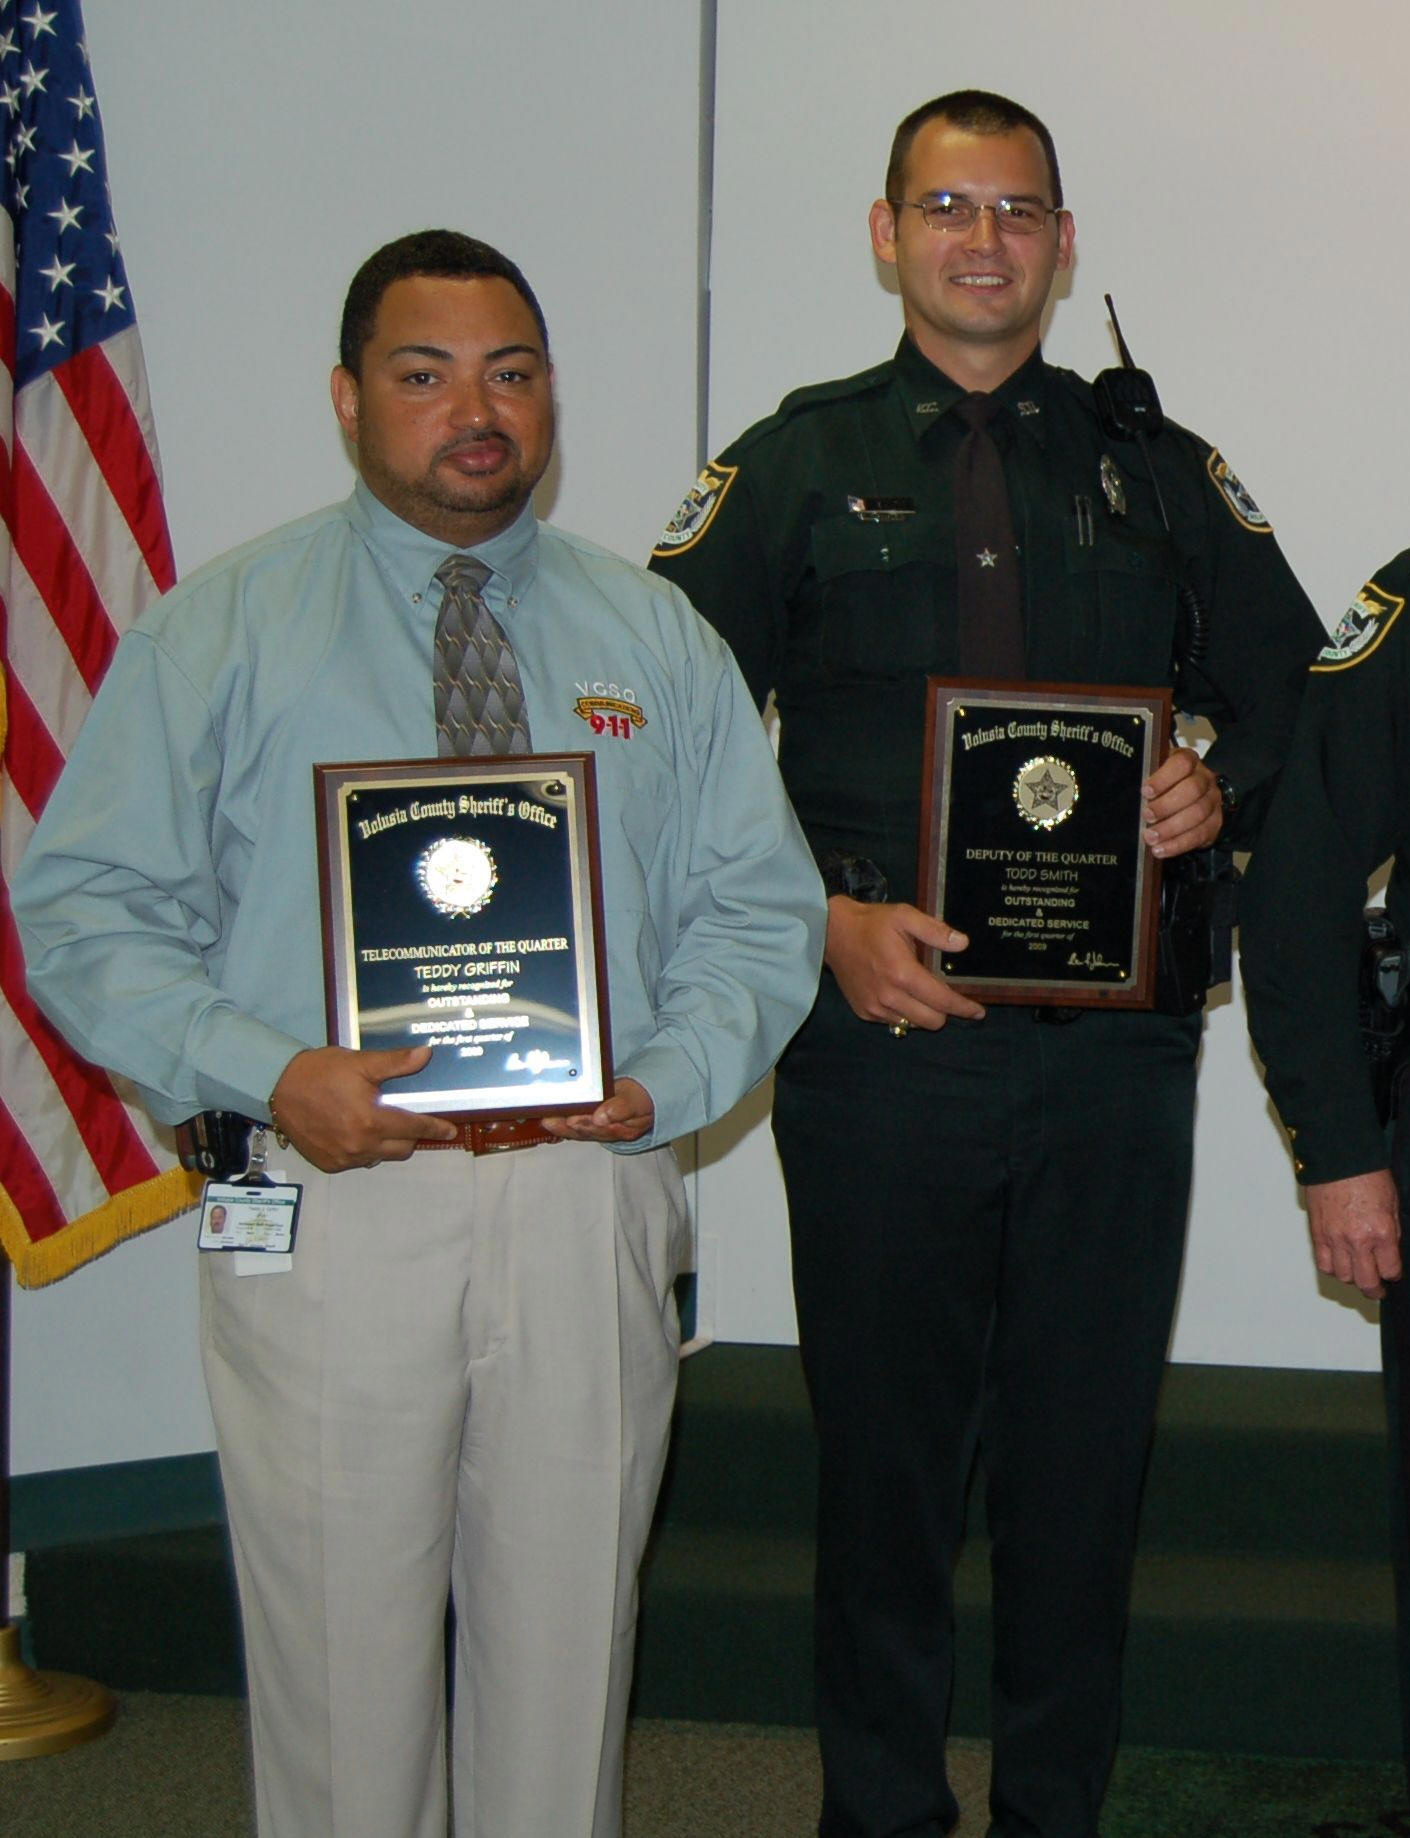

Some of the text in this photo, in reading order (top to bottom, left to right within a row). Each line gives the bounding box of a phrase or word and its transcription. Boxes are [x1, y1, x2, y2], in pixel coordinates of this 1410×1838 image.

[962, 720, 1134, 758] Volusia County Sheriff's Office
[358, 795, 557, 839] Volusia County Sheriff's Office
[966, 849, 1118, 865] DEPUTY OF THE QUARTER
[1006, 868, 1078, 881] TODD SMITH
[1009, 884, 1031, 893] hereby
[1032, 885, 1068, 894] recognized
[1067, 886, 1080, 895] for
[1005, 896, 1076, 907] OUTSTANDING
[1035, 908, 1043, 917] &
[988, 917, 1089, 930] DEDICATED SERVICE
[1001, 930, 1014, 939] for
[1023, 931, 1039, 940] first
[1040, 932, 1066, 940] quarter
[1066, 932, 1075, 941] of
[362, 938, 568, 961] TELECOMMUNICATOR OF THE QUARTER
[1028, 942, 1047, 950] 2009
[414, 960, 520, 979] TEDDY GRIFFIN
[431, 981, 457, 993] hereby
[459, 979, 500, 992] recognized
[499, 979, 513, 990] for
[427, 993, 510, 1009] OUTSTANDING
[411, 1018, 477, 1034] DEDICATED
